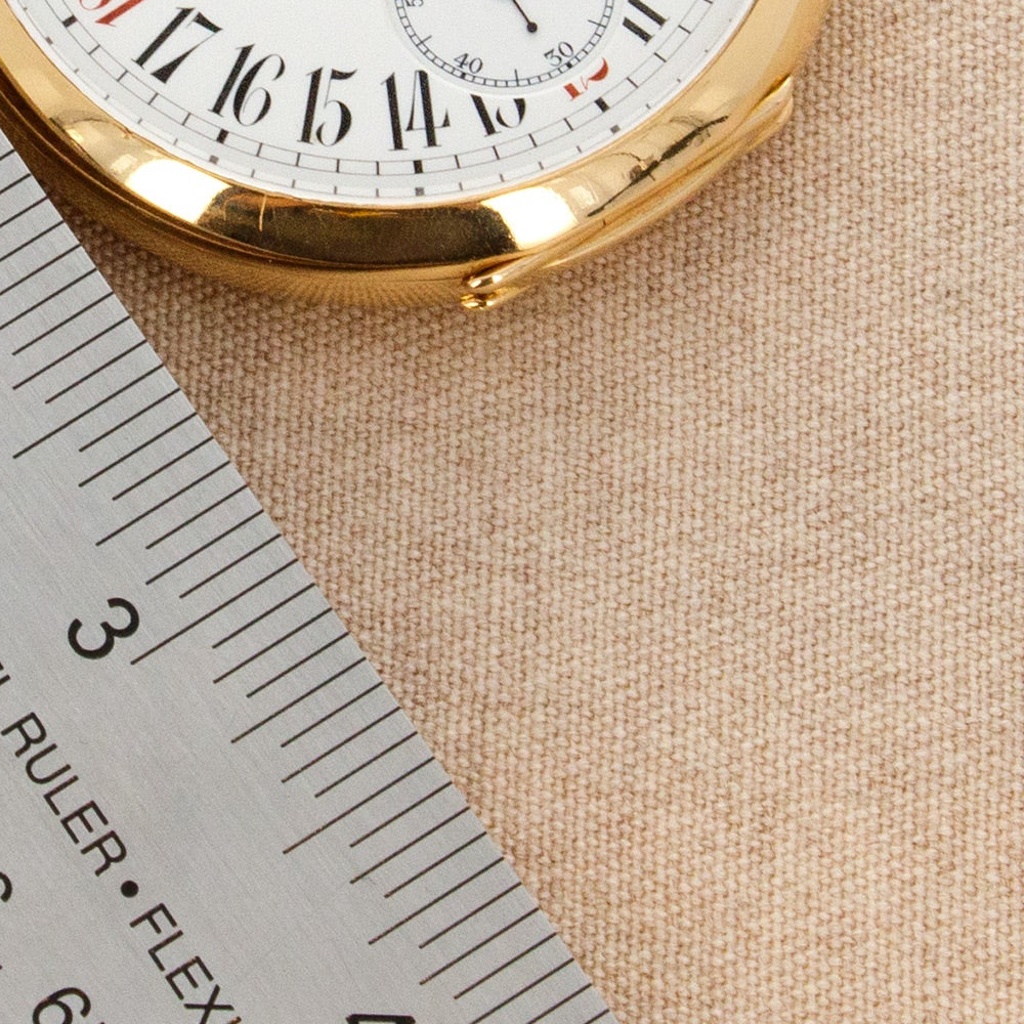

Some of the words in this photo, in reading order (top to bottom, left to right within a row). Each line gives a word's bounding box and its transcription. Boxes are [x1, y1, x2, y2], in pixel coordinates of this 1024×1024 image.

[131, 7, 224, 84] 17
[453, 52, 483, 74] 40
[544, 41, 574, 67] 30
[208, 43, 286, 127] 16
[297, 66, 358, 147] 15
[380, 69, 451, 151] 14
[67, 596, 140, 660] 3
[0, 712, 127, 877] RULER
[129, 903, 241, 1024] FLEX
[31, 986, 105, 1024] 9
